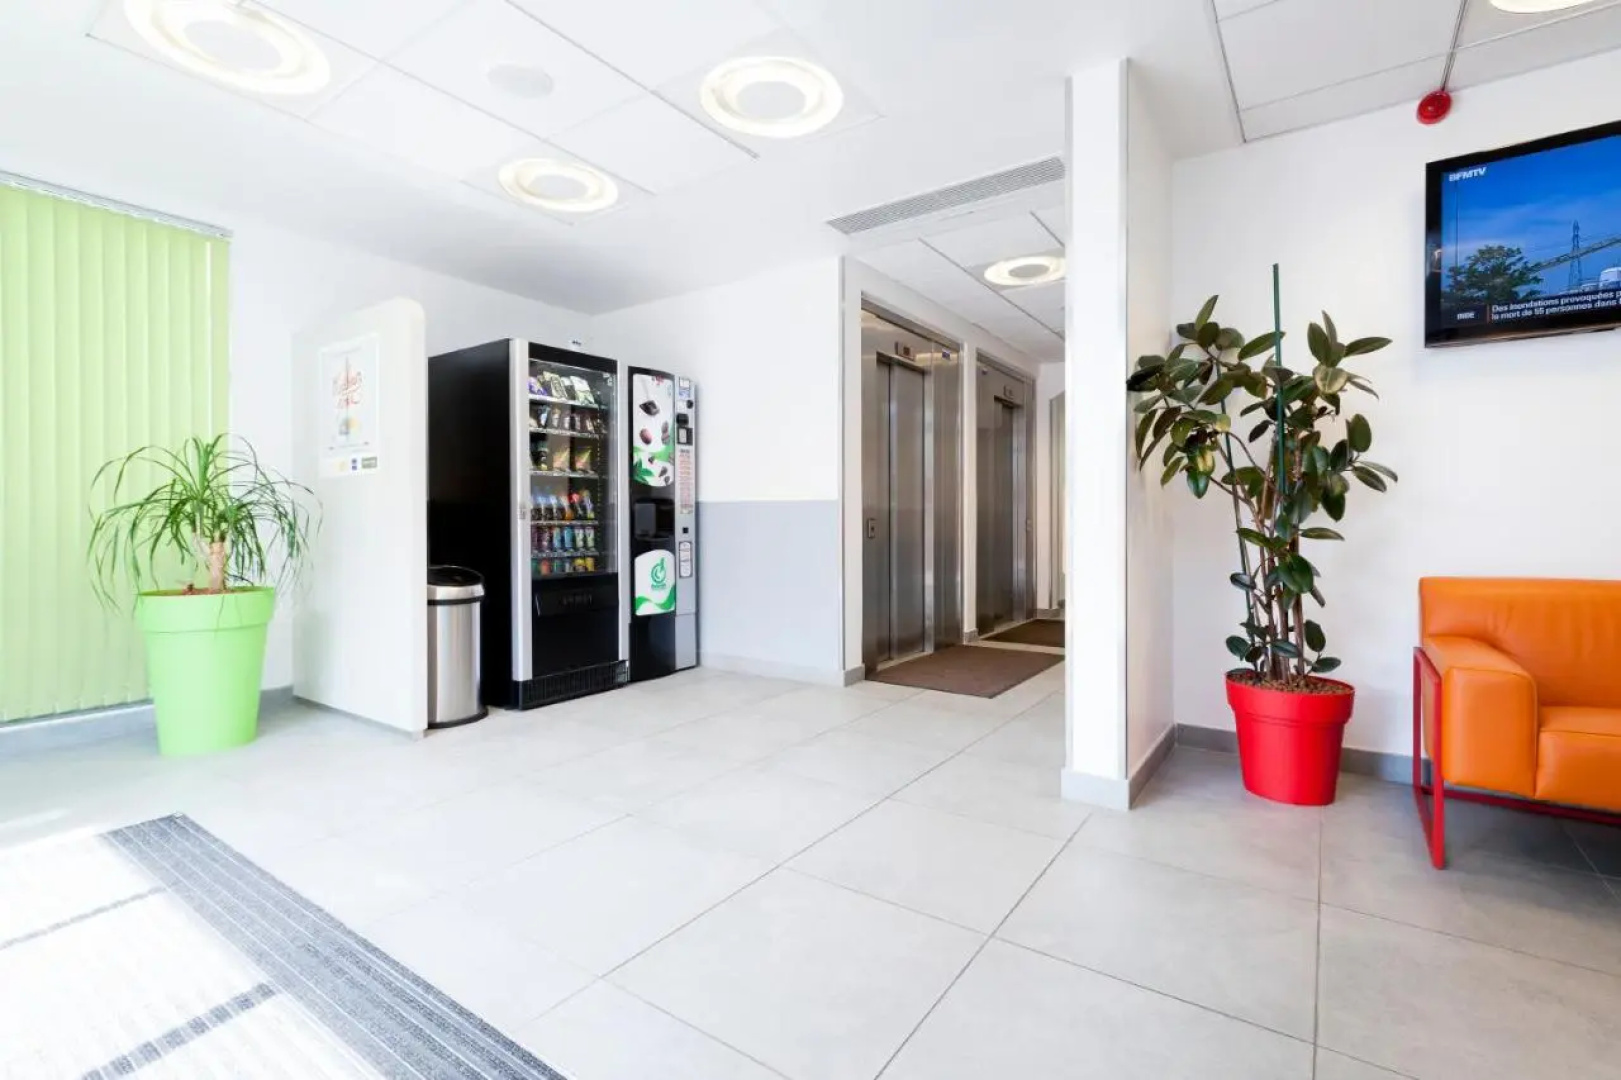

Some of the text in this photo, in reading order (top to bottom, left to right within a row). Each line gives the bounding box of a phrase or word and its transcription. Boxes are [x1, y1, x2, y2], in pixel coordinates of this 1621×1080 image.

[1449, 166, 1487, 181] BFMTV
[1492, 304, 1508, 313] Des
[1509, 299, 1559, 310] inondations
[1560, 292, 1614, 305] provoquées
[1500, 311, 1520, 319] mort
[1521, 308, 1532, 317] de
[1545, 303, 1592, 315] personnes
[1594, 300, 1617, 308] dans
